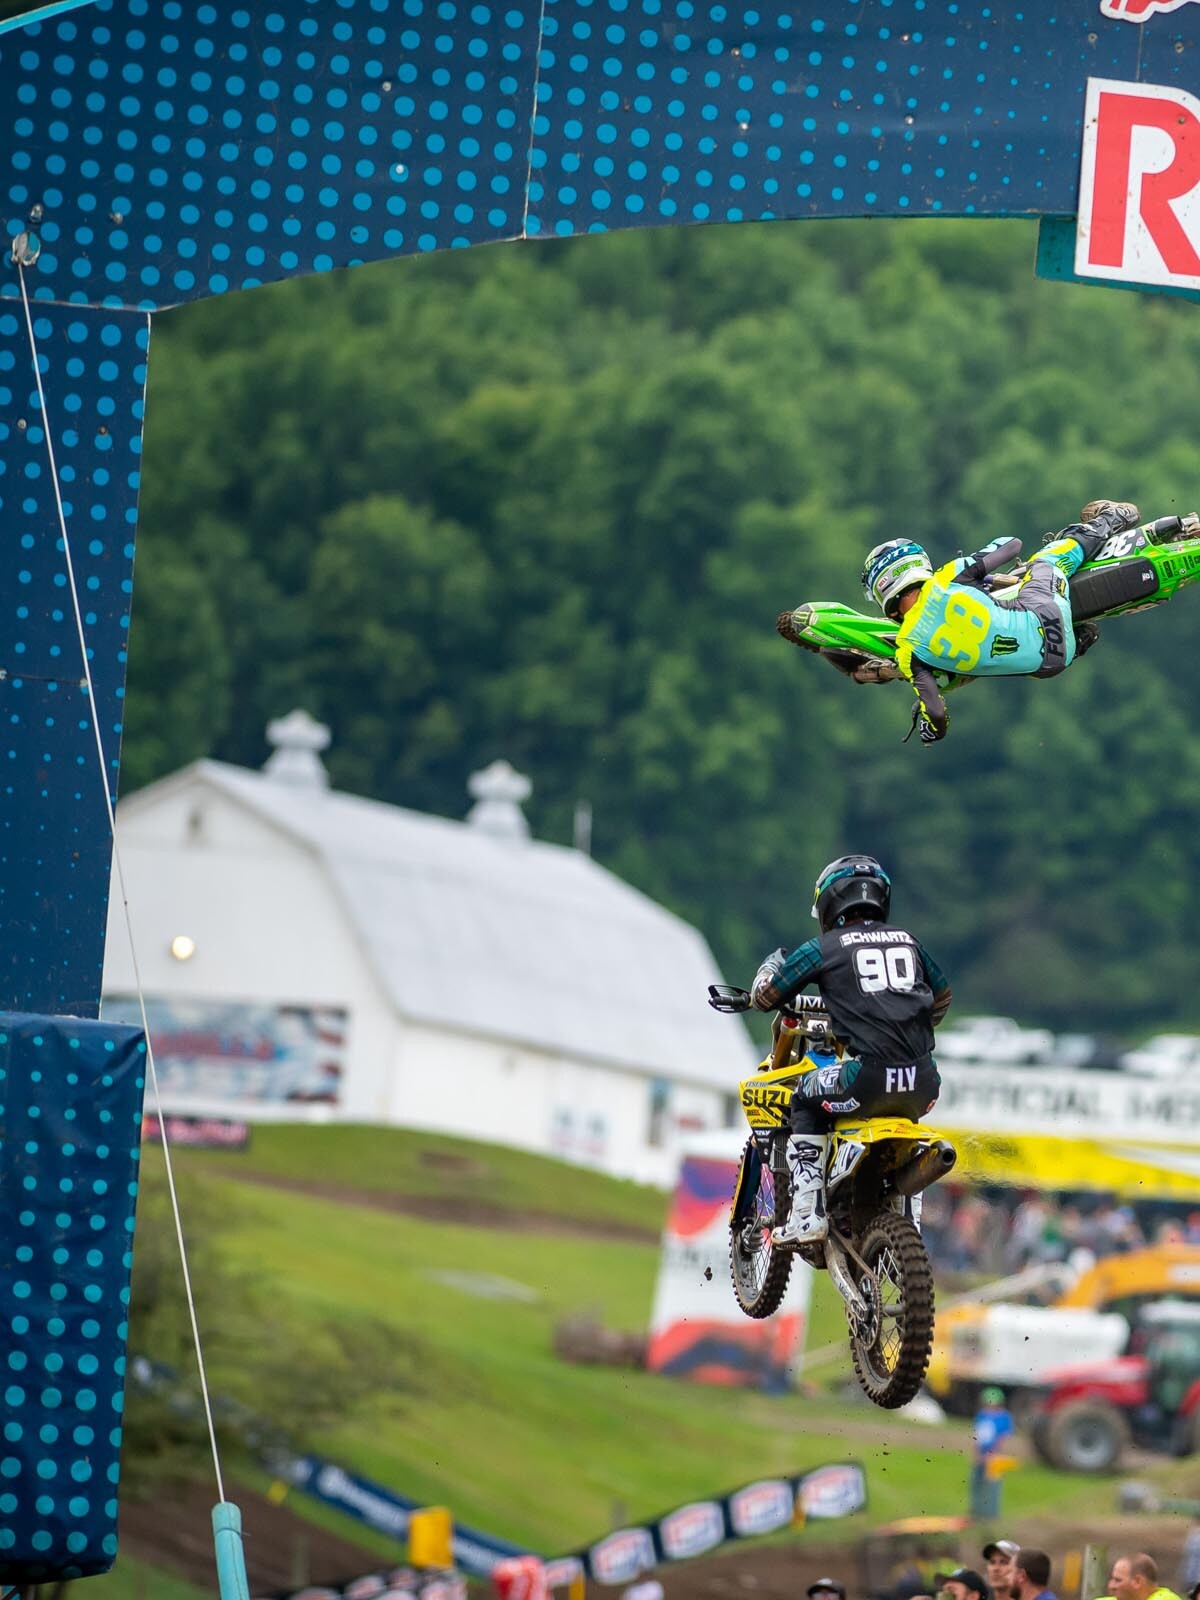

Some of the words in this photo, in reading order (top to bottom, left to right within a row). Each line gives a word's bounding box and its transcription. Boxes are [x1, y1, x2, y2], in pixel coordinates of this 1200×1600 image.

[929, 591, 991, 672] 38
[1040, 613, 1064, 657] FOX
[841, 931, 914, 947] SCHWARTZ
[856, 948, 915, 993] 90
[886, 1066, 916, 1093] FLY
[742, 1089, 792, 1107] SUZU
